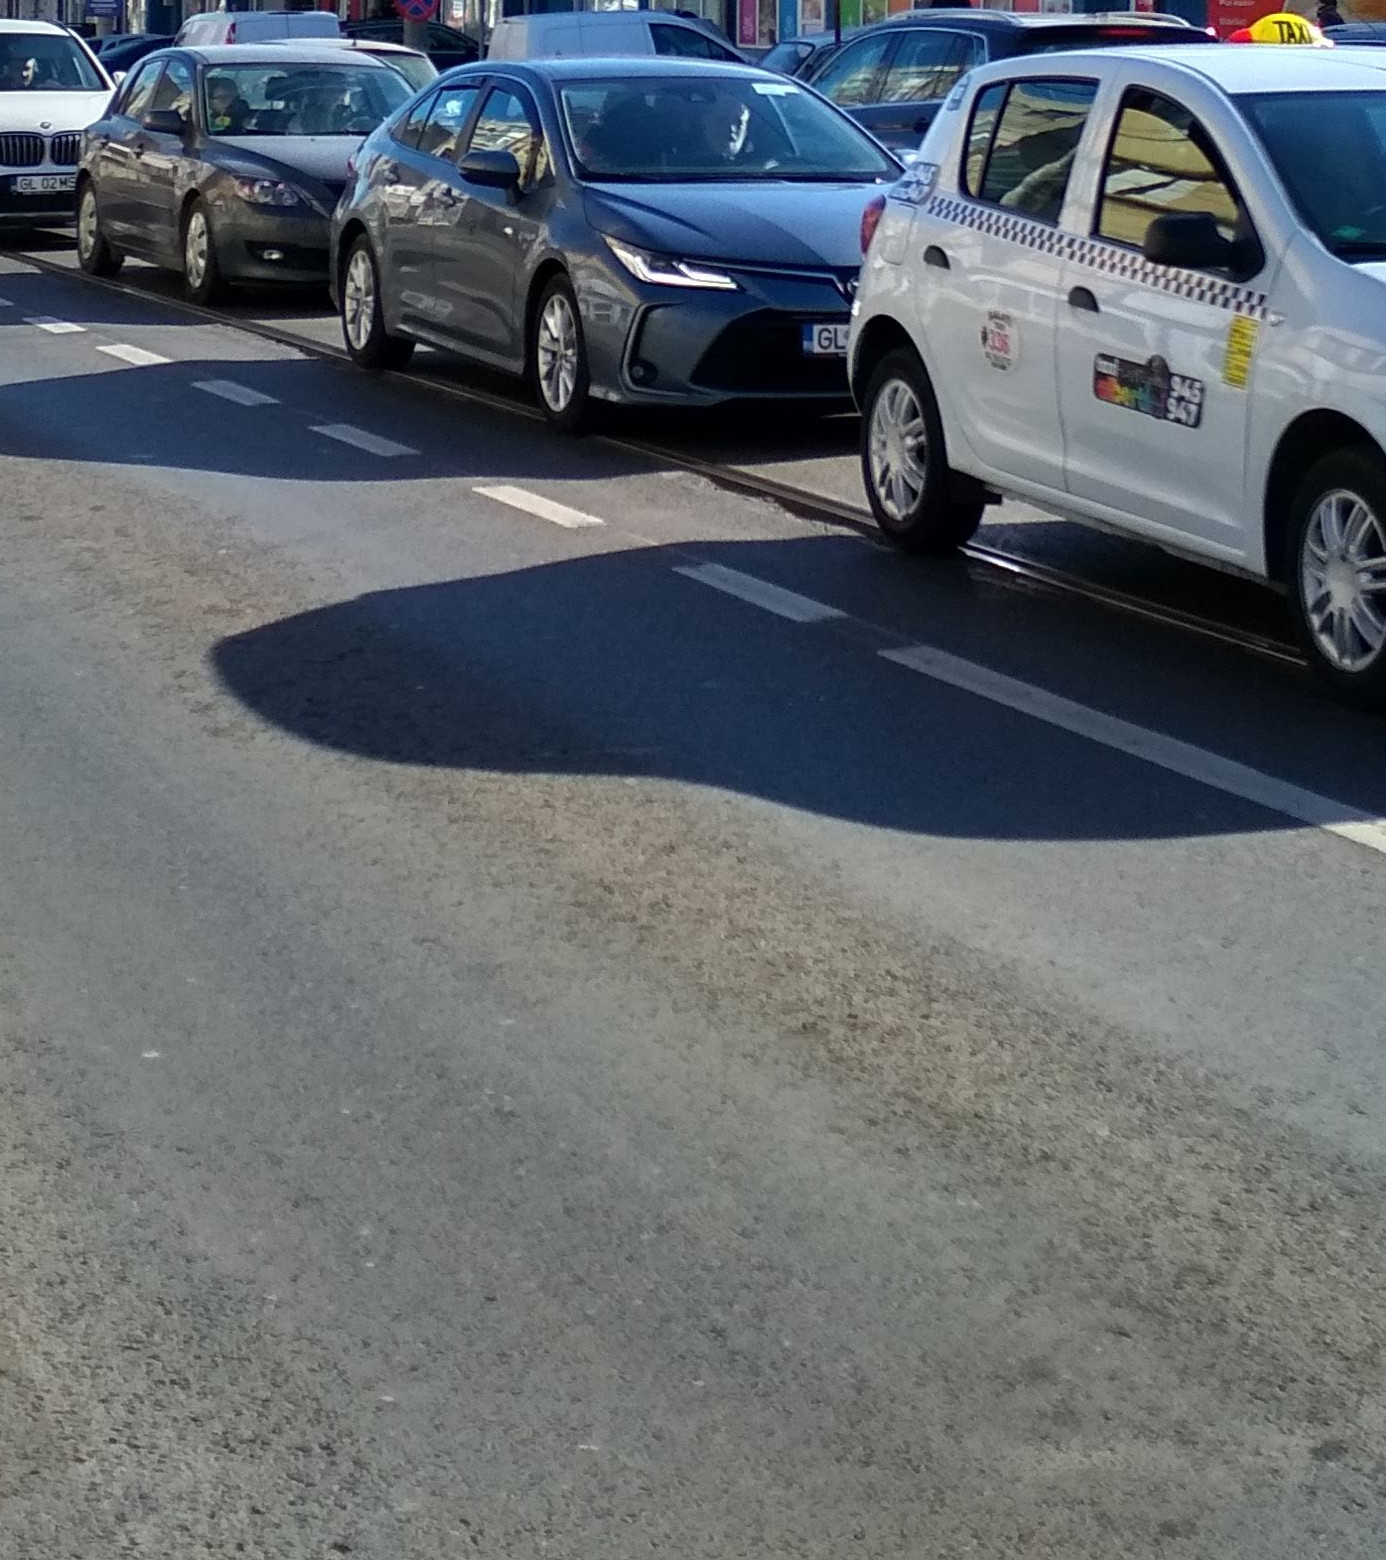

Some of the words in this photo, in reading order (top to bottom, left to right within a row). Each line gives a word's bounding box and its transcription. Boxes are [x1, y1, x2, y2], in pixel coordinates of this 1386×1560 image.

[1272, 21, 1312, 44] TAXI
[20, 179, 37, 190] GL
[818, 328, 845, 350] GL
